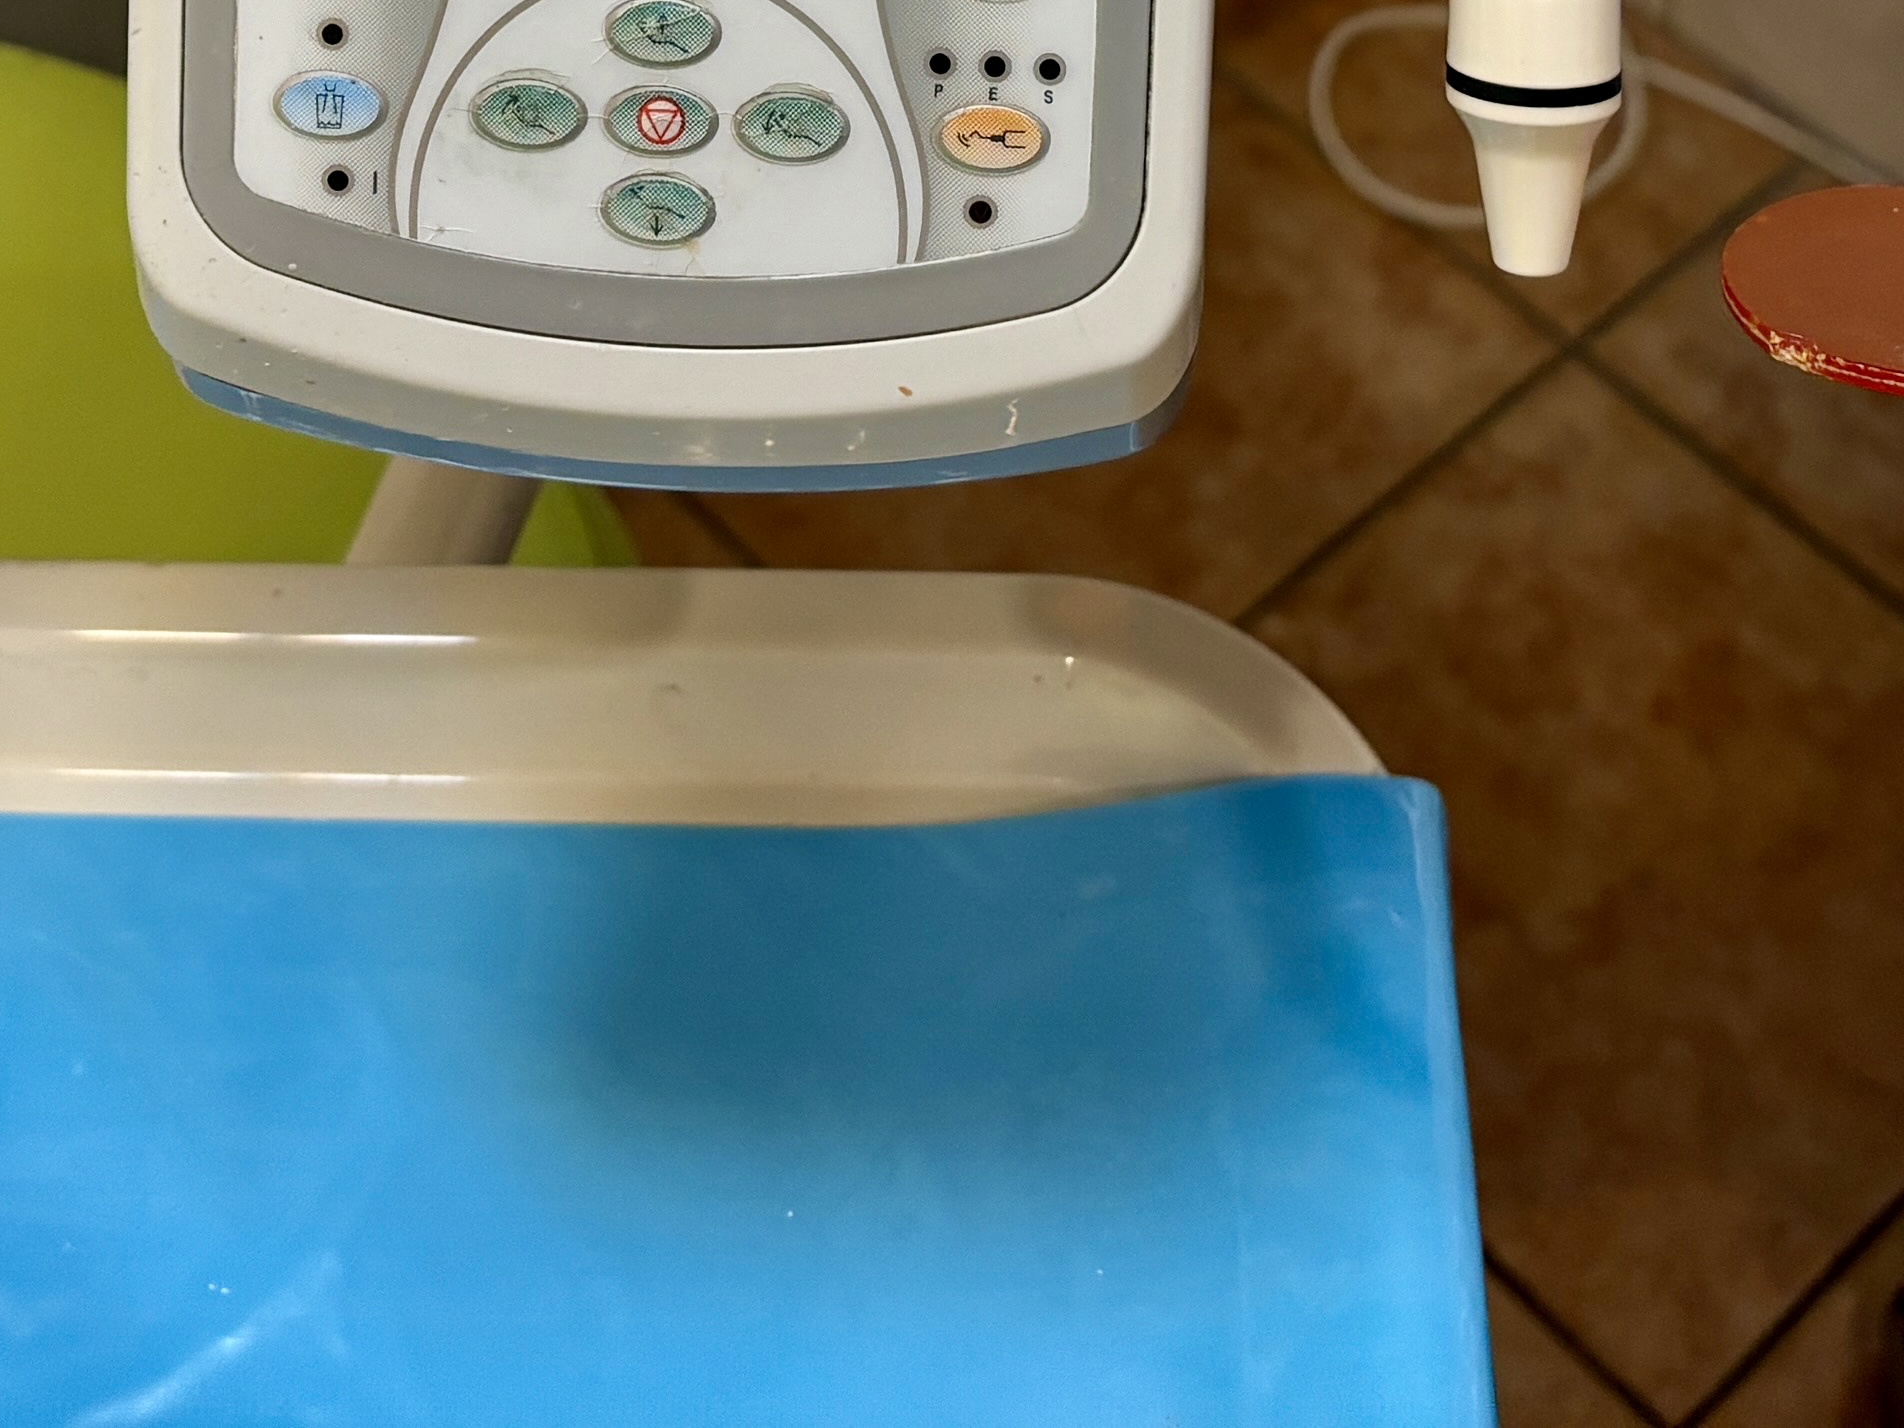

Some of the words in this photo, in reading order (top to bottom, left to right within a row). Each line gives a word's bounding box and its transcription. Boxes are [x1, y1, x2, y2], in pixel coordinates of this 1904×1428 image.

[934, 83, 944, 98] P
[988, 87, 999, 101] E
[1044, 90, 1054, 104] S
